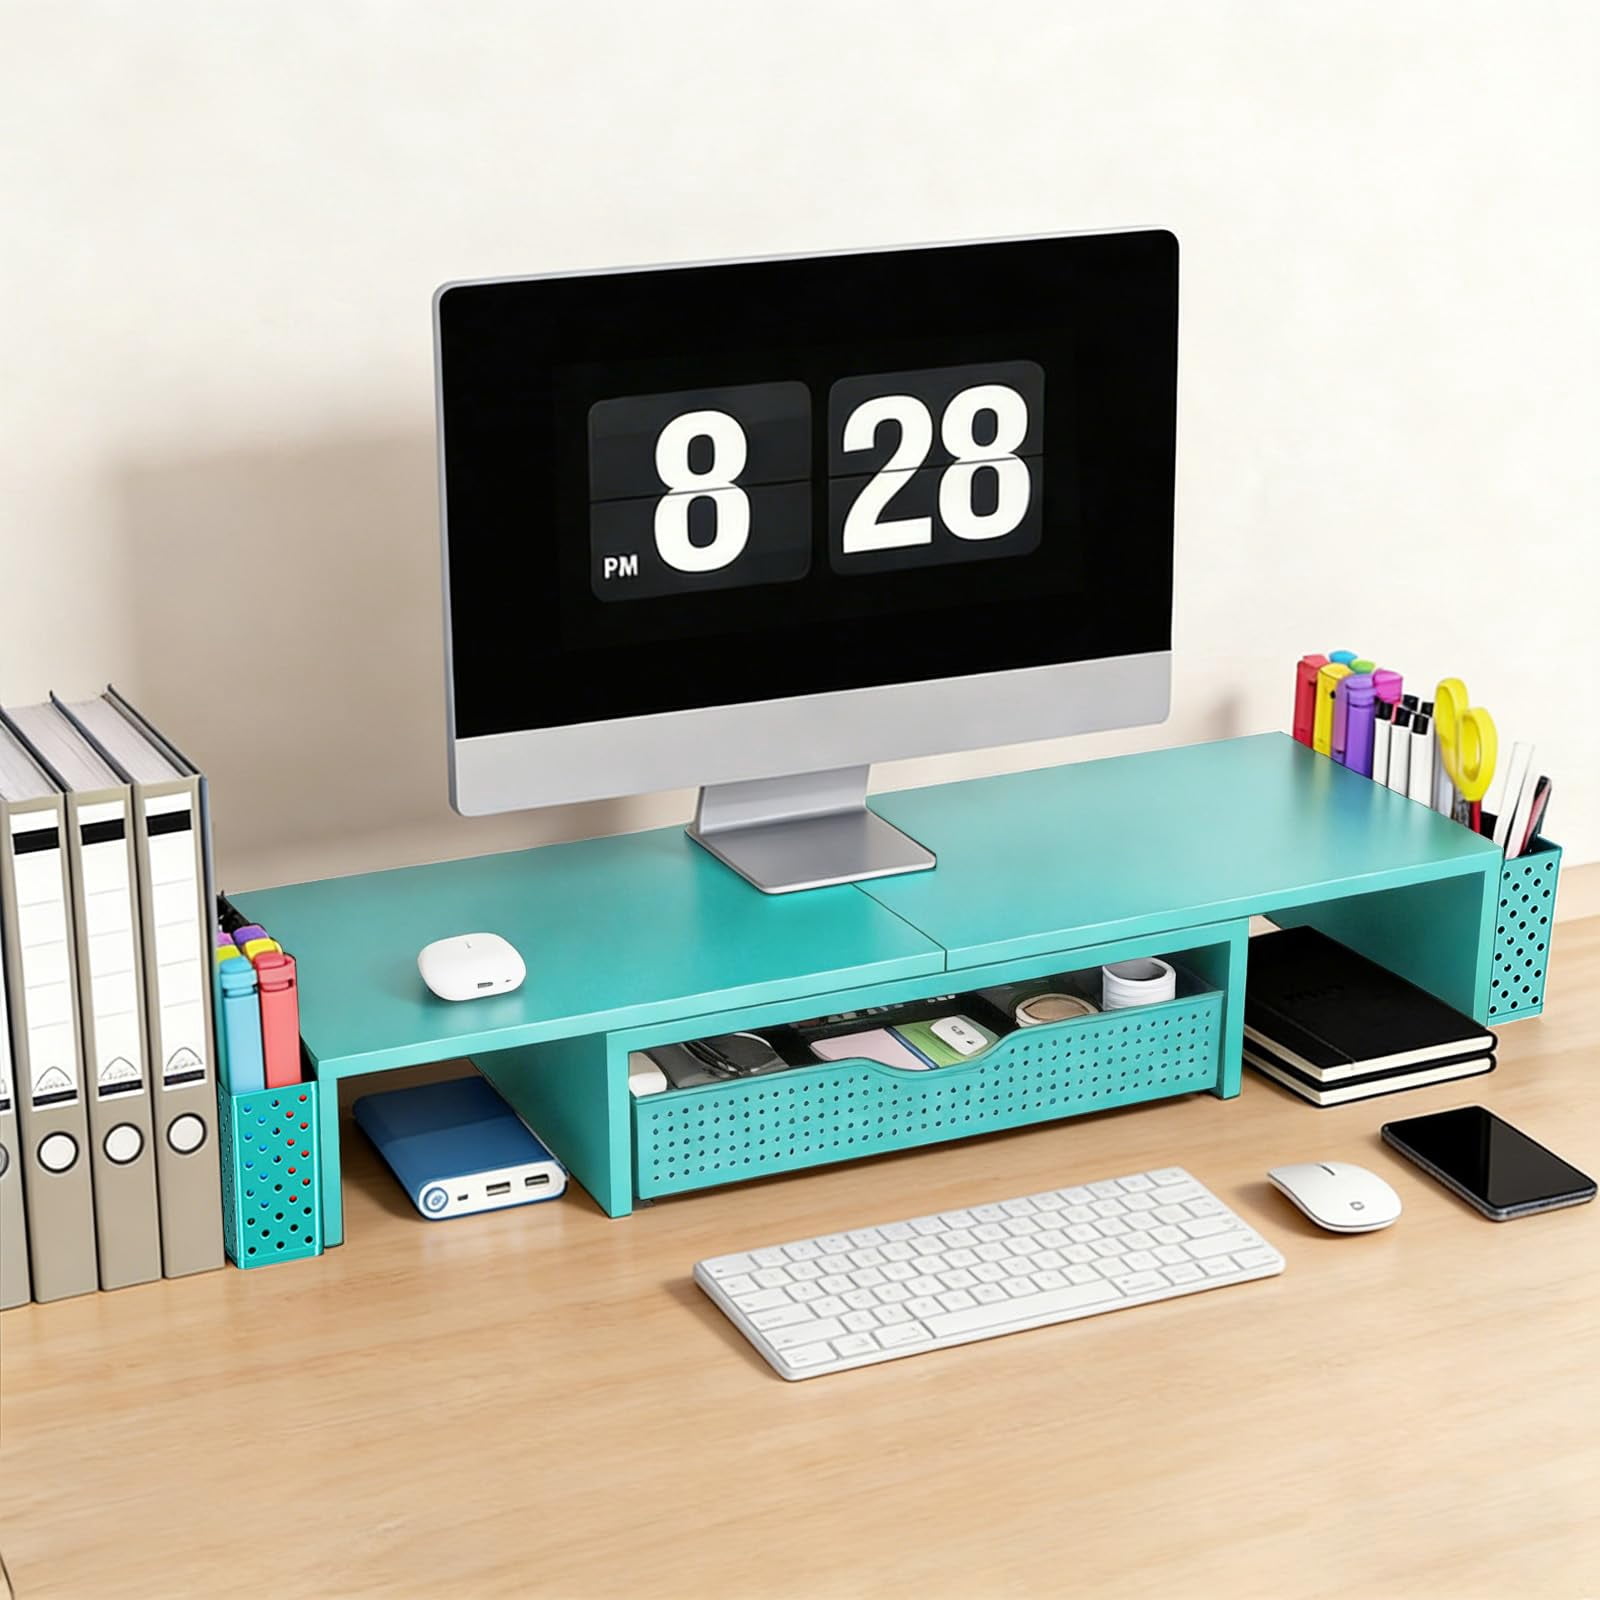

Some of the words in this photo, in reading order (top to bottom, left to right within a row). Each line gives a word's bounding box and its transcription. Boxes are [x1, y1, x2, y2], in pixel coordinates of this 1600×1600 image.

[655, 410, 751, 572] 8
[843, 384, 1031, 554] 28
[604, 554, 638, 579] PM
